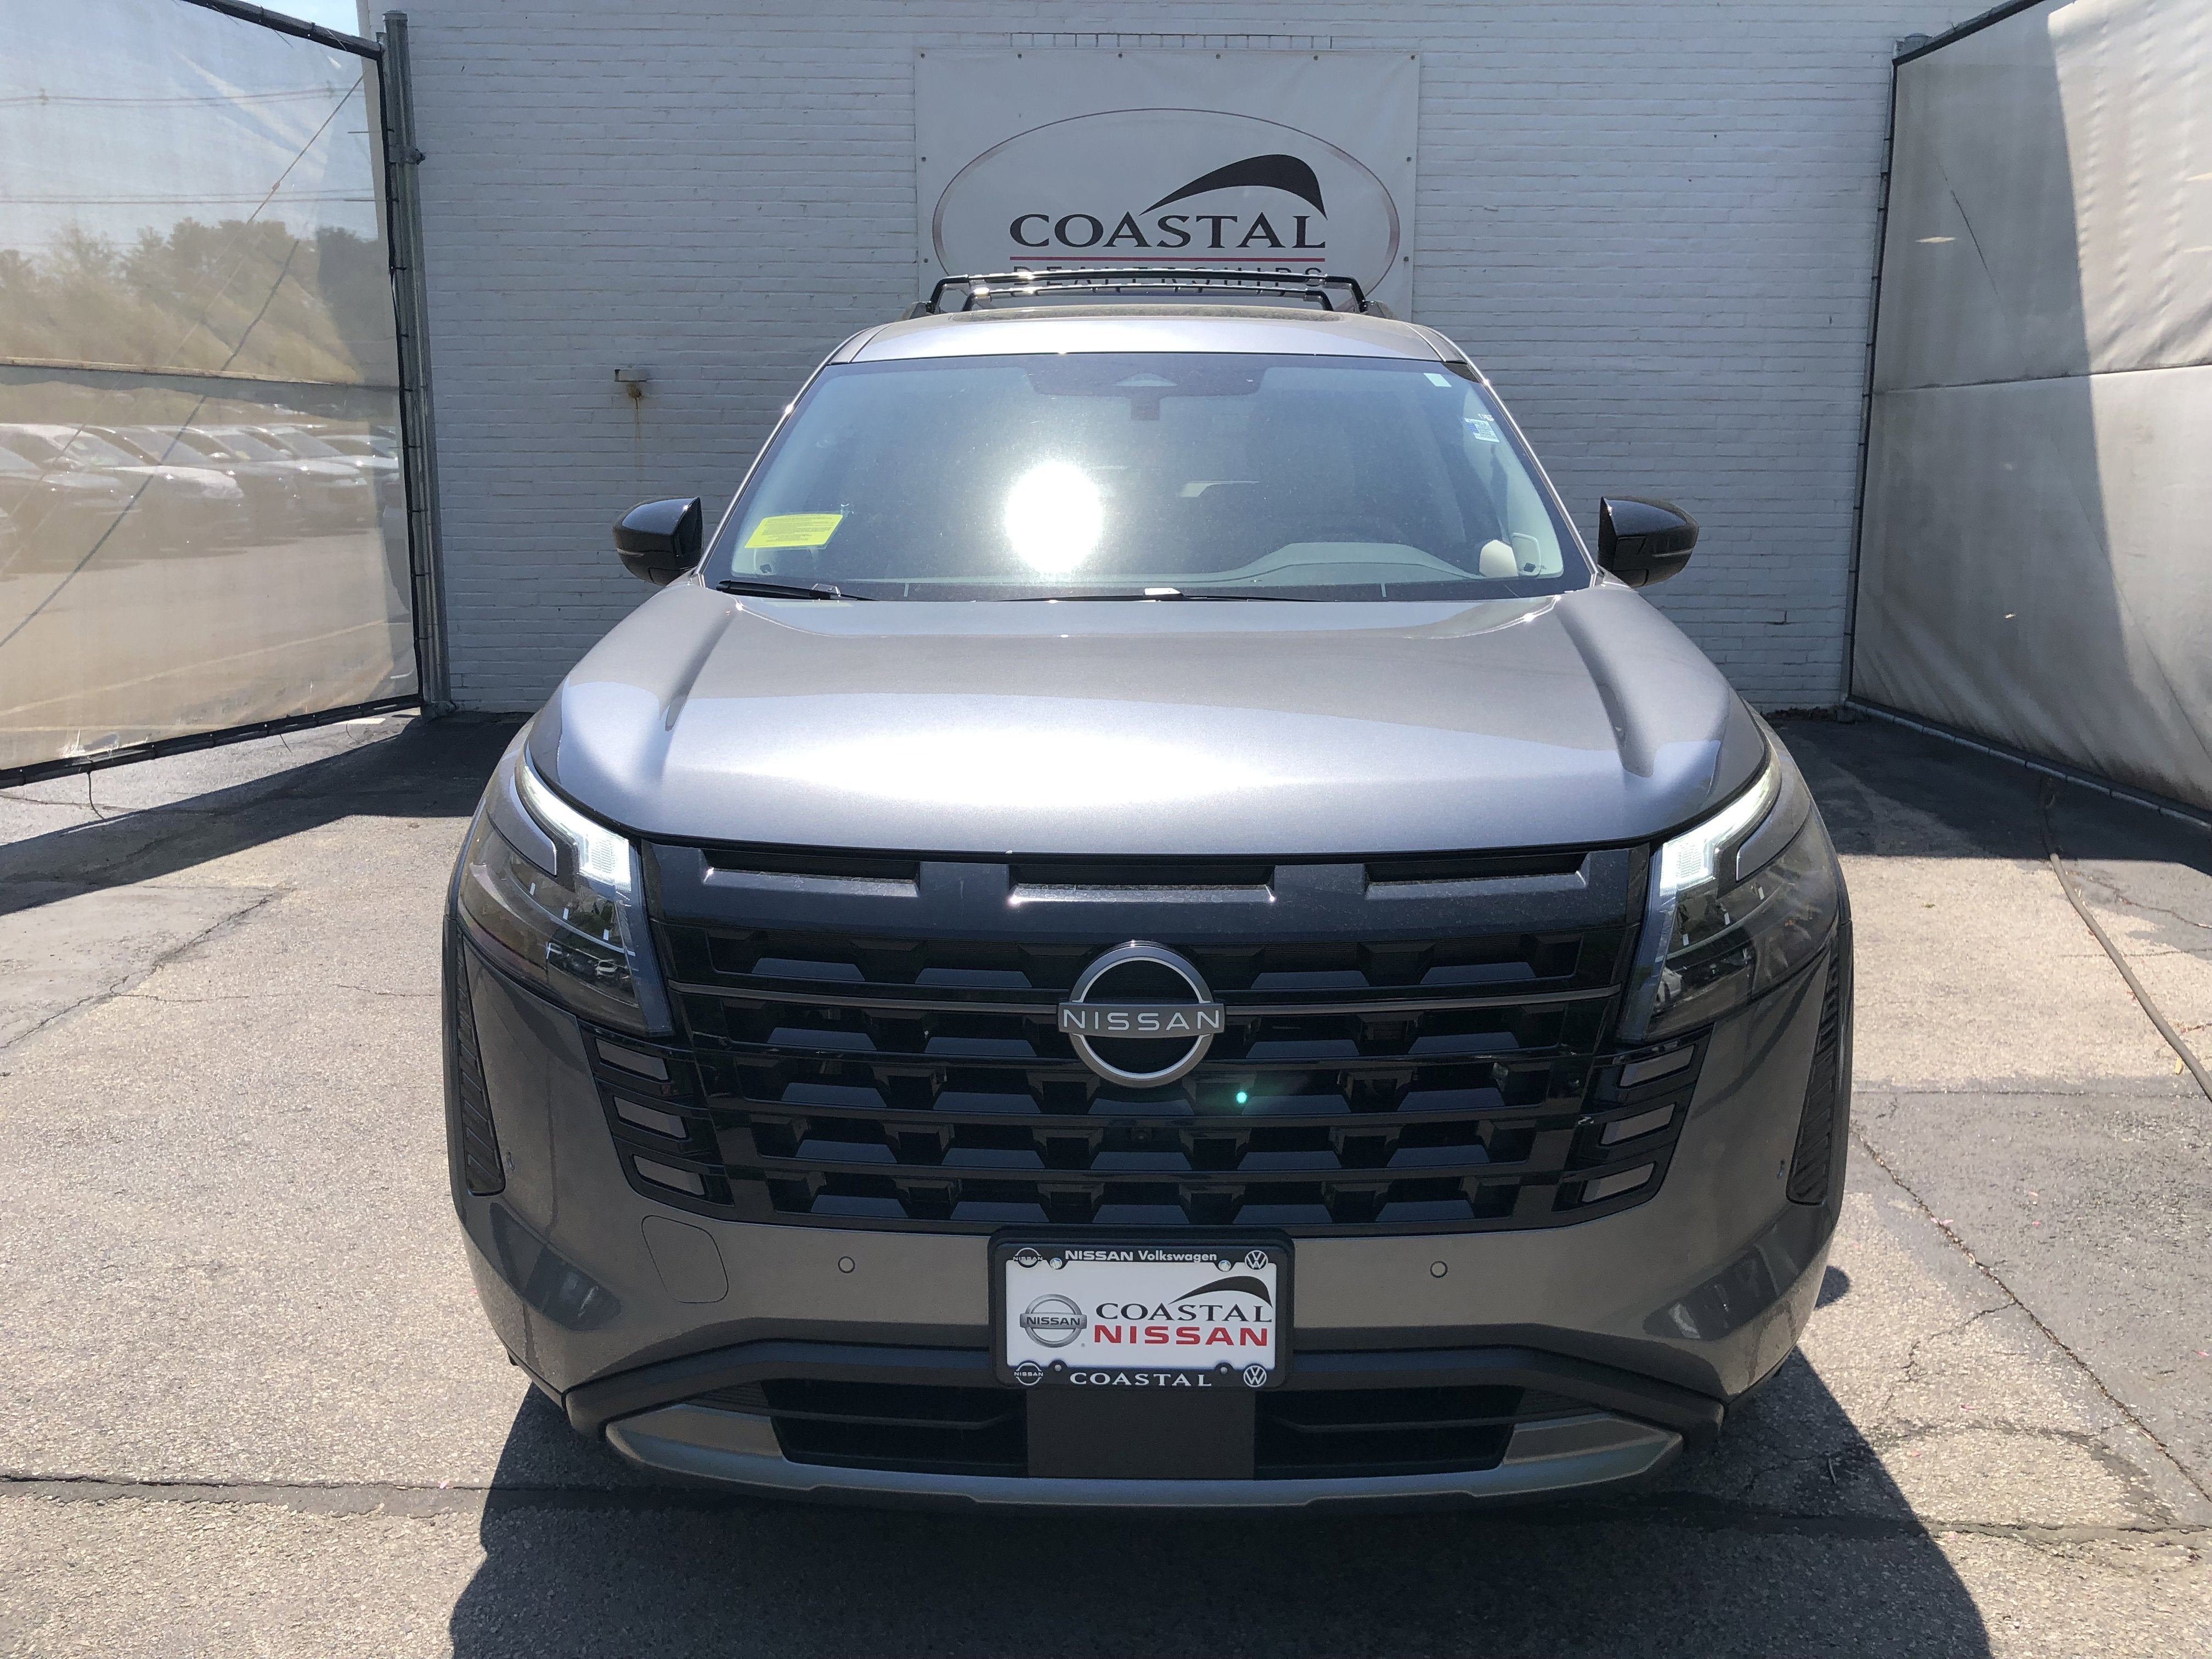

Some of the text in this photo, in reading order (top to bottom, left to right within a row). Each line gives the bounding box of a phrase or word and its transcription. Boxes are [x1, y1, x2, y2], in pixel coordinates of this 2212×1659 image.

[1010, 212, 1326, 249] COASTAL
[1064, 1009, 1219, 1031] NISSAN
[1065, 1250, 1217, 1262] NISSAN Volkswagen
[1026, 1317, 1080, 1326] NISSAN
[1096, 1302, 1272, 1323] COASTAL
[1094, 1325, 1267, 1346] NISSAN
[1070, 1372, 1211, 1386] COASTAL
